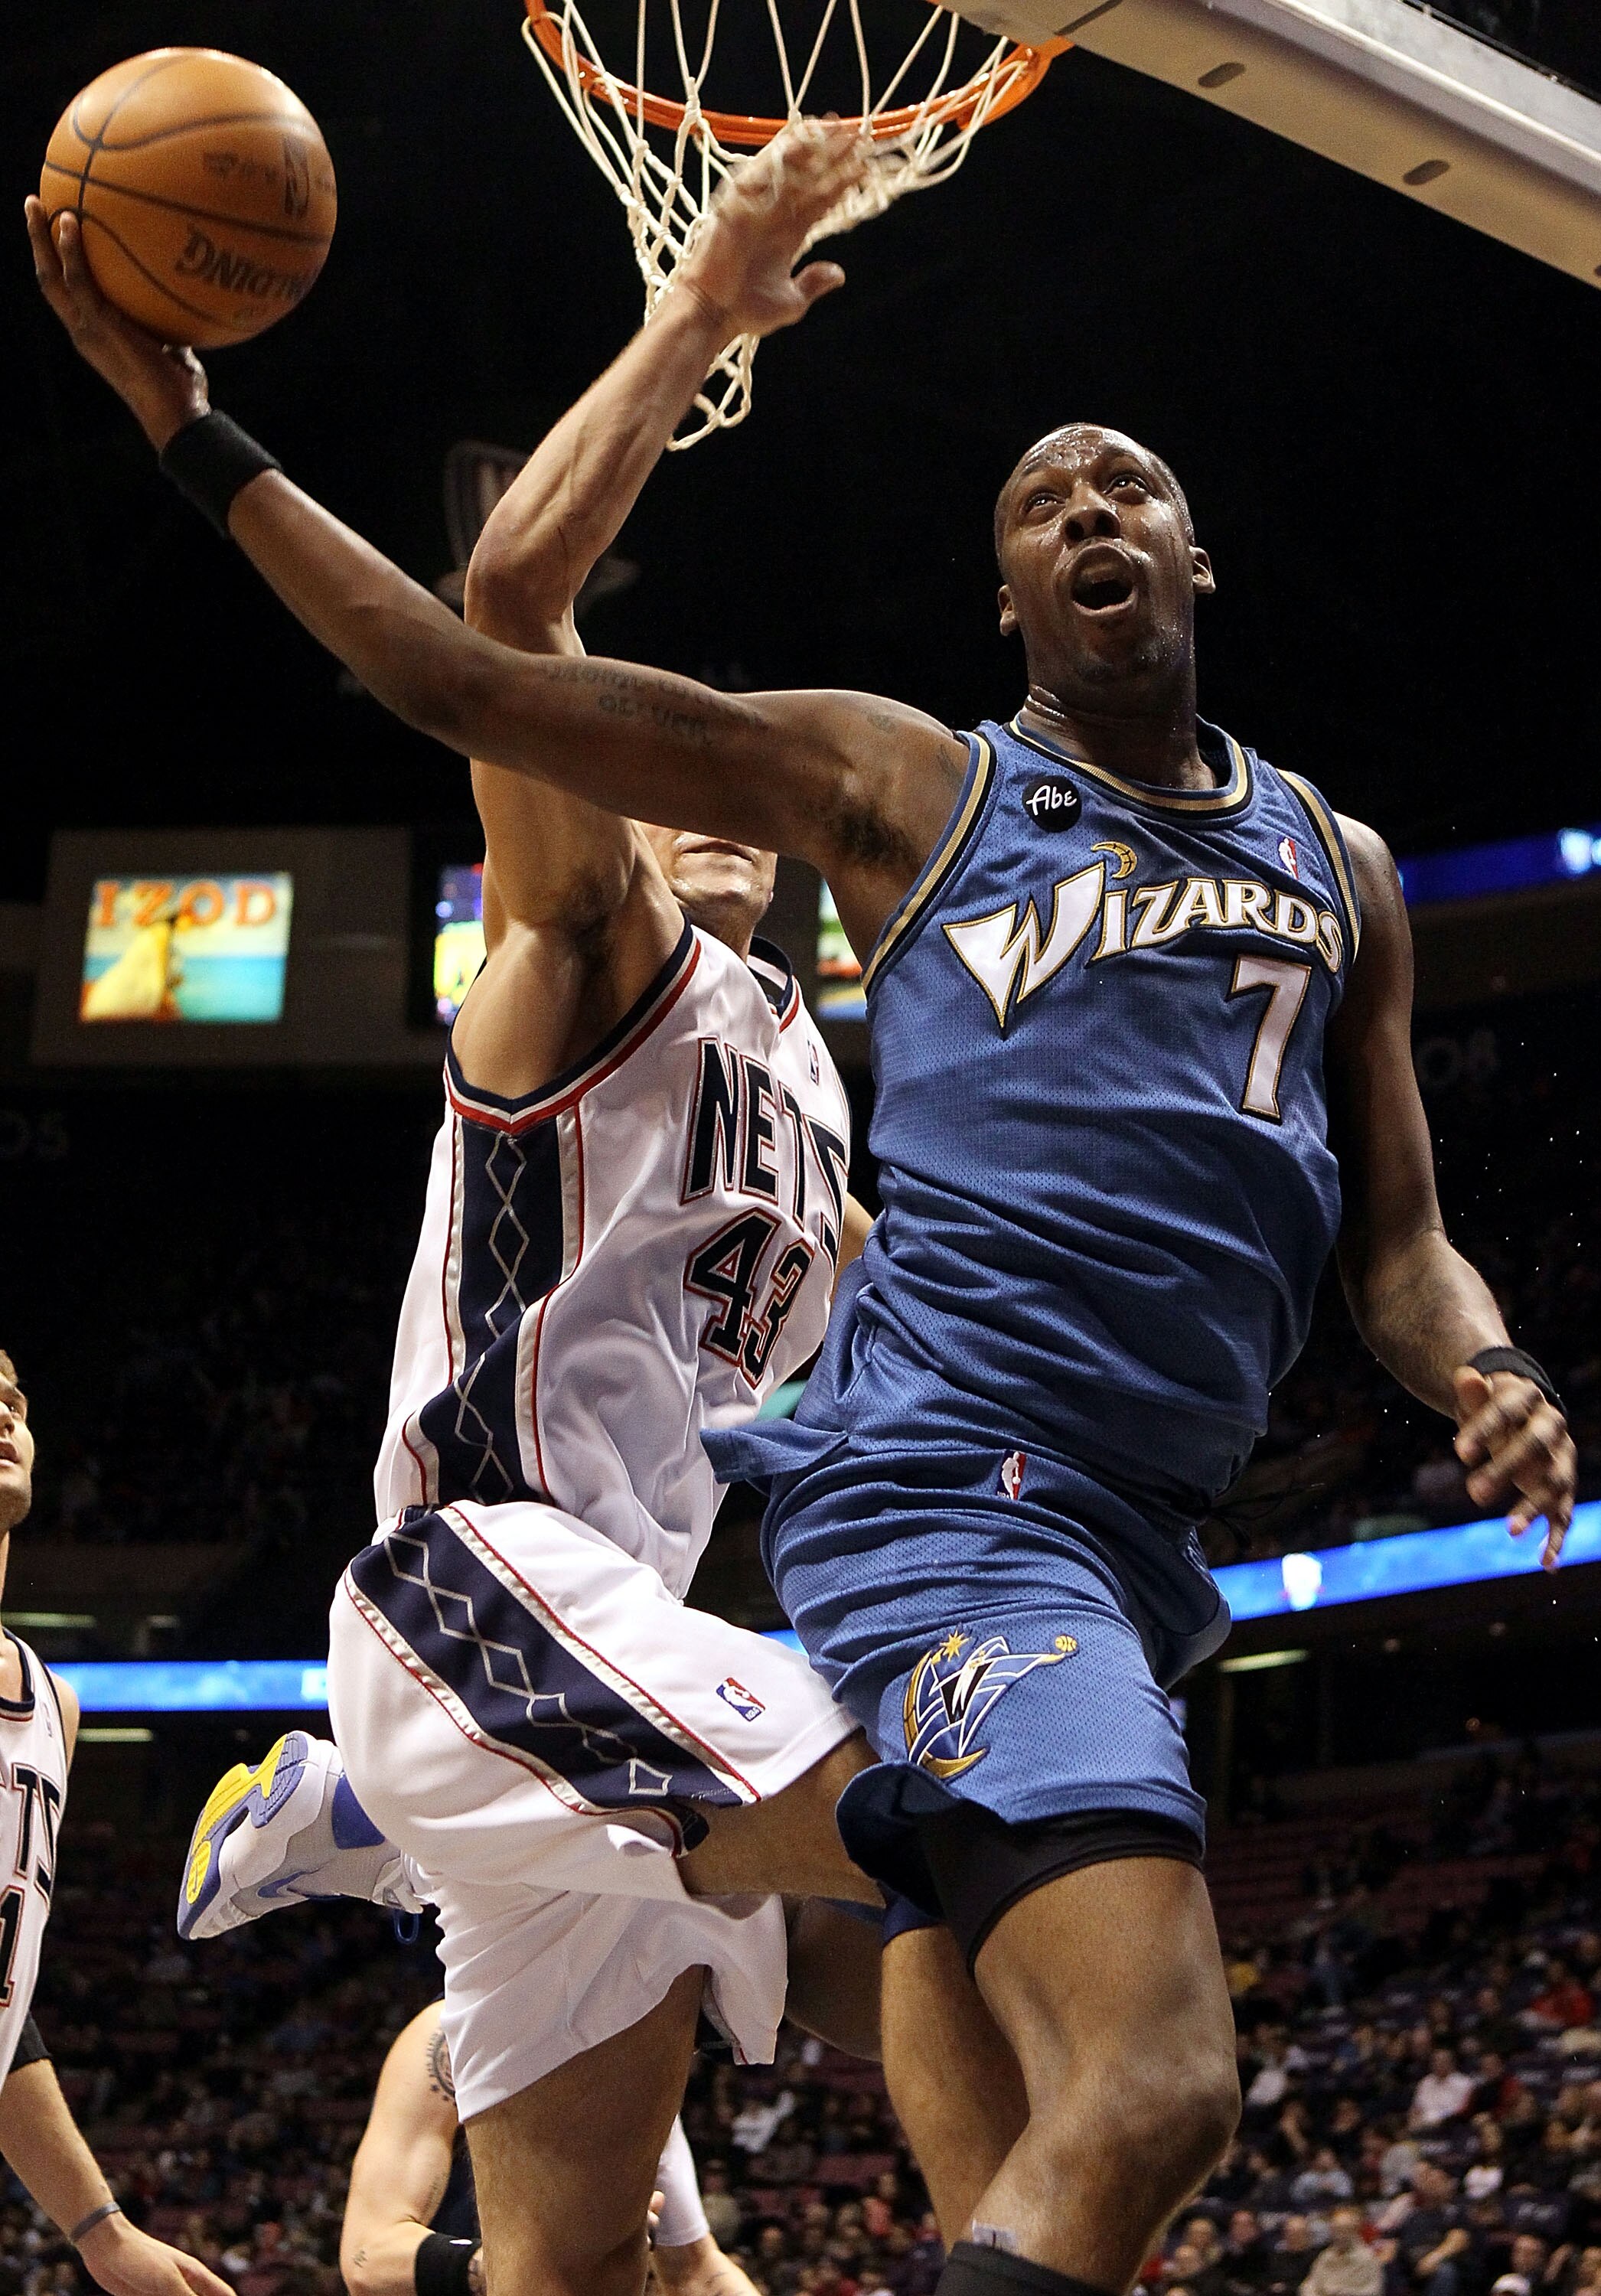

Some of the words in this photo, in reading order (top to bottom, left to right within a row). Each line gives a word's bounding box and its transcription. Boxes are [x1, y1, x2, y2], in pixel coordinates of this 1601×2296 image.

[1026, 785, 1077, 815] Abe
[96, 881, 276, 926] IZOD
[944, 859, 1346, 1030] WIZARDS
[1228, 955, 1311, 1124] 7
[680, 1037, 849, 1275] NETS
[684, 1207, 814, 1390] 43
